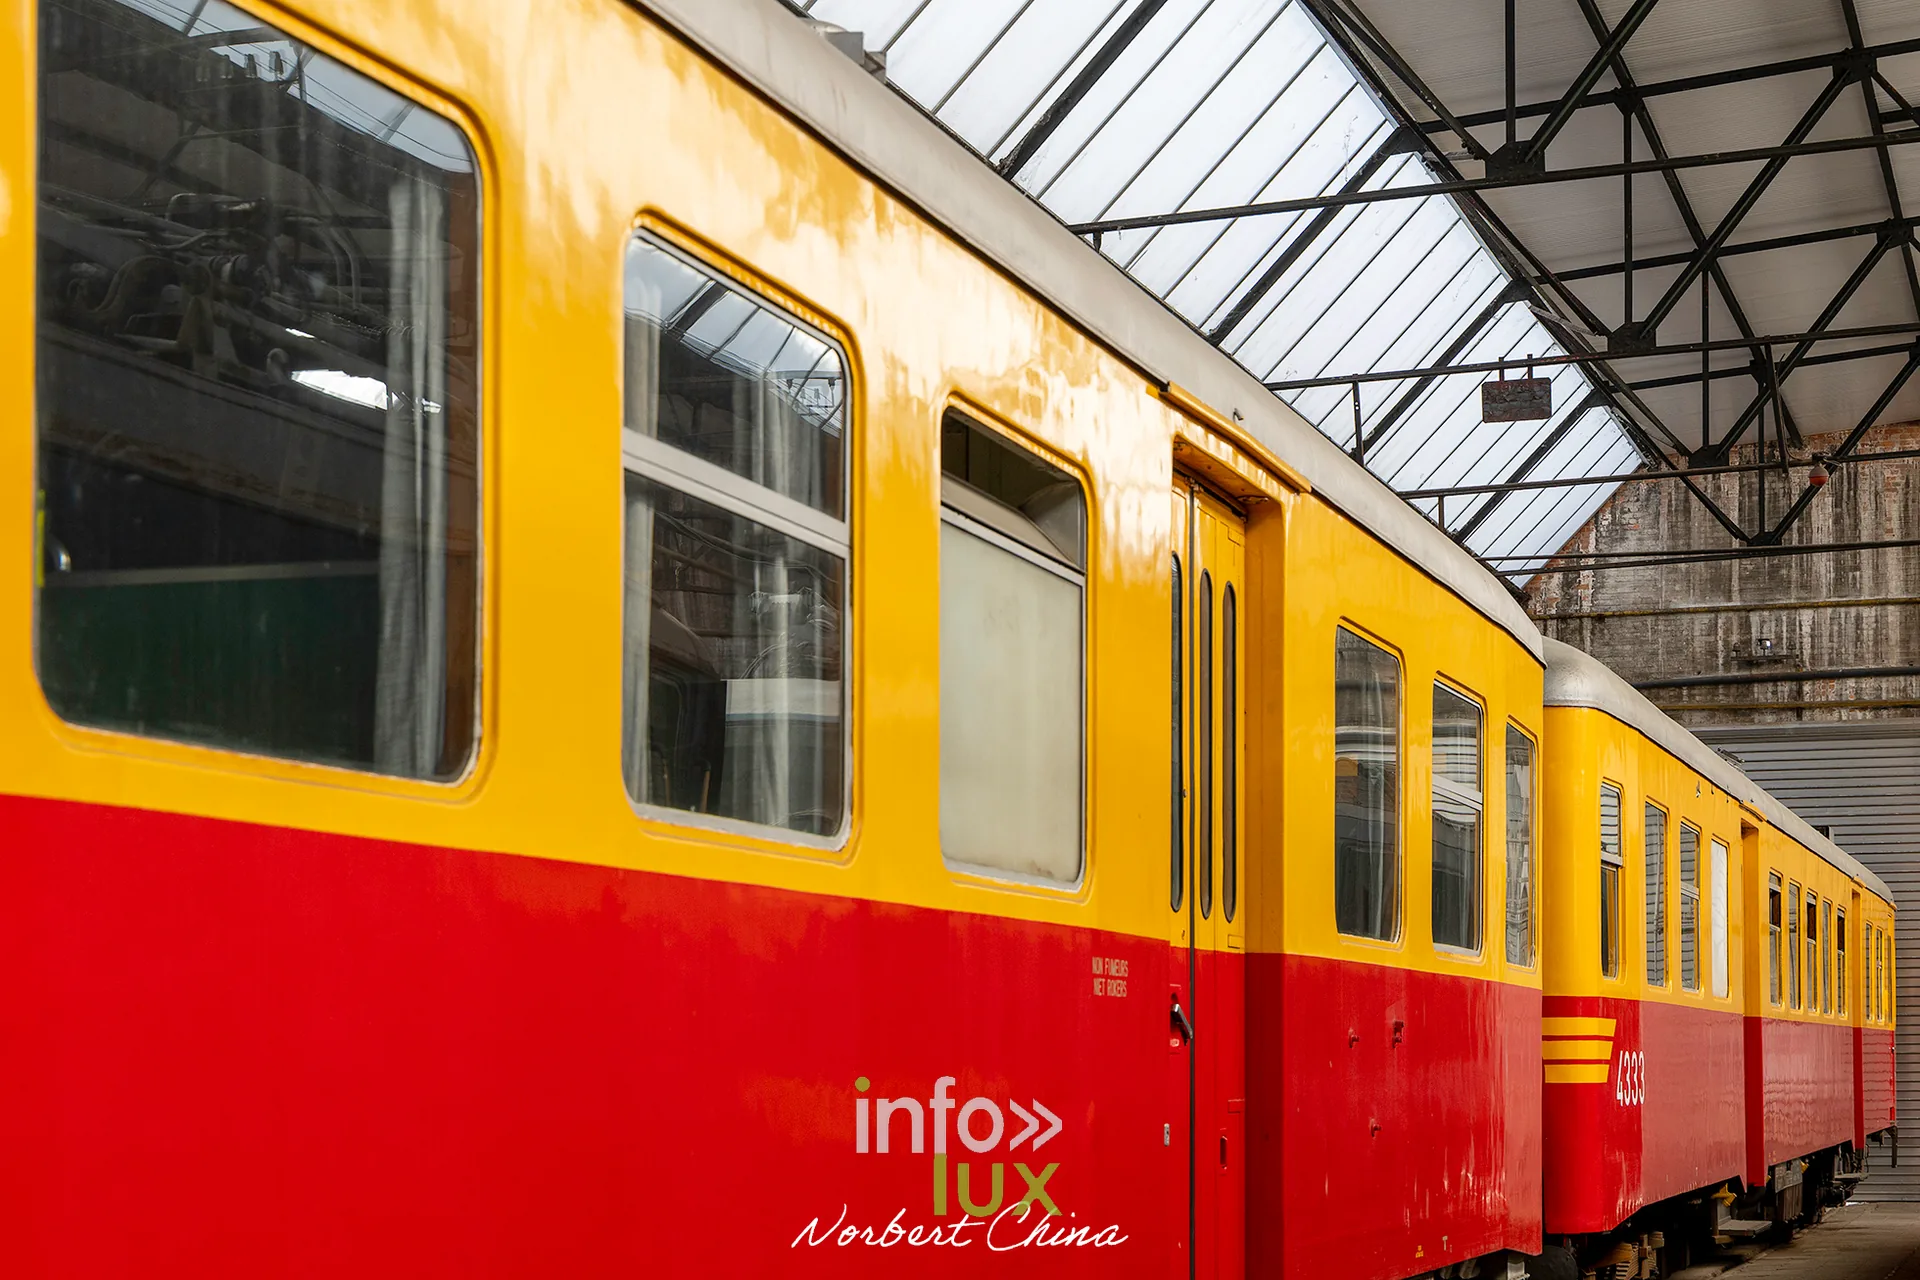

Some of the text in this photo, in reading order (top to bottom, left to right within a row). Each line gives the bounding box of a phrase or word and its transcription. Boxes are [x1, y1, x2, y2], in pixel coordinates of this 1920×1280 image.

[1092, 956, 1103, 975] NON
[1093, 978, 1106, 996] NIET
[1616, 1050, 1645, 1107] 4333
